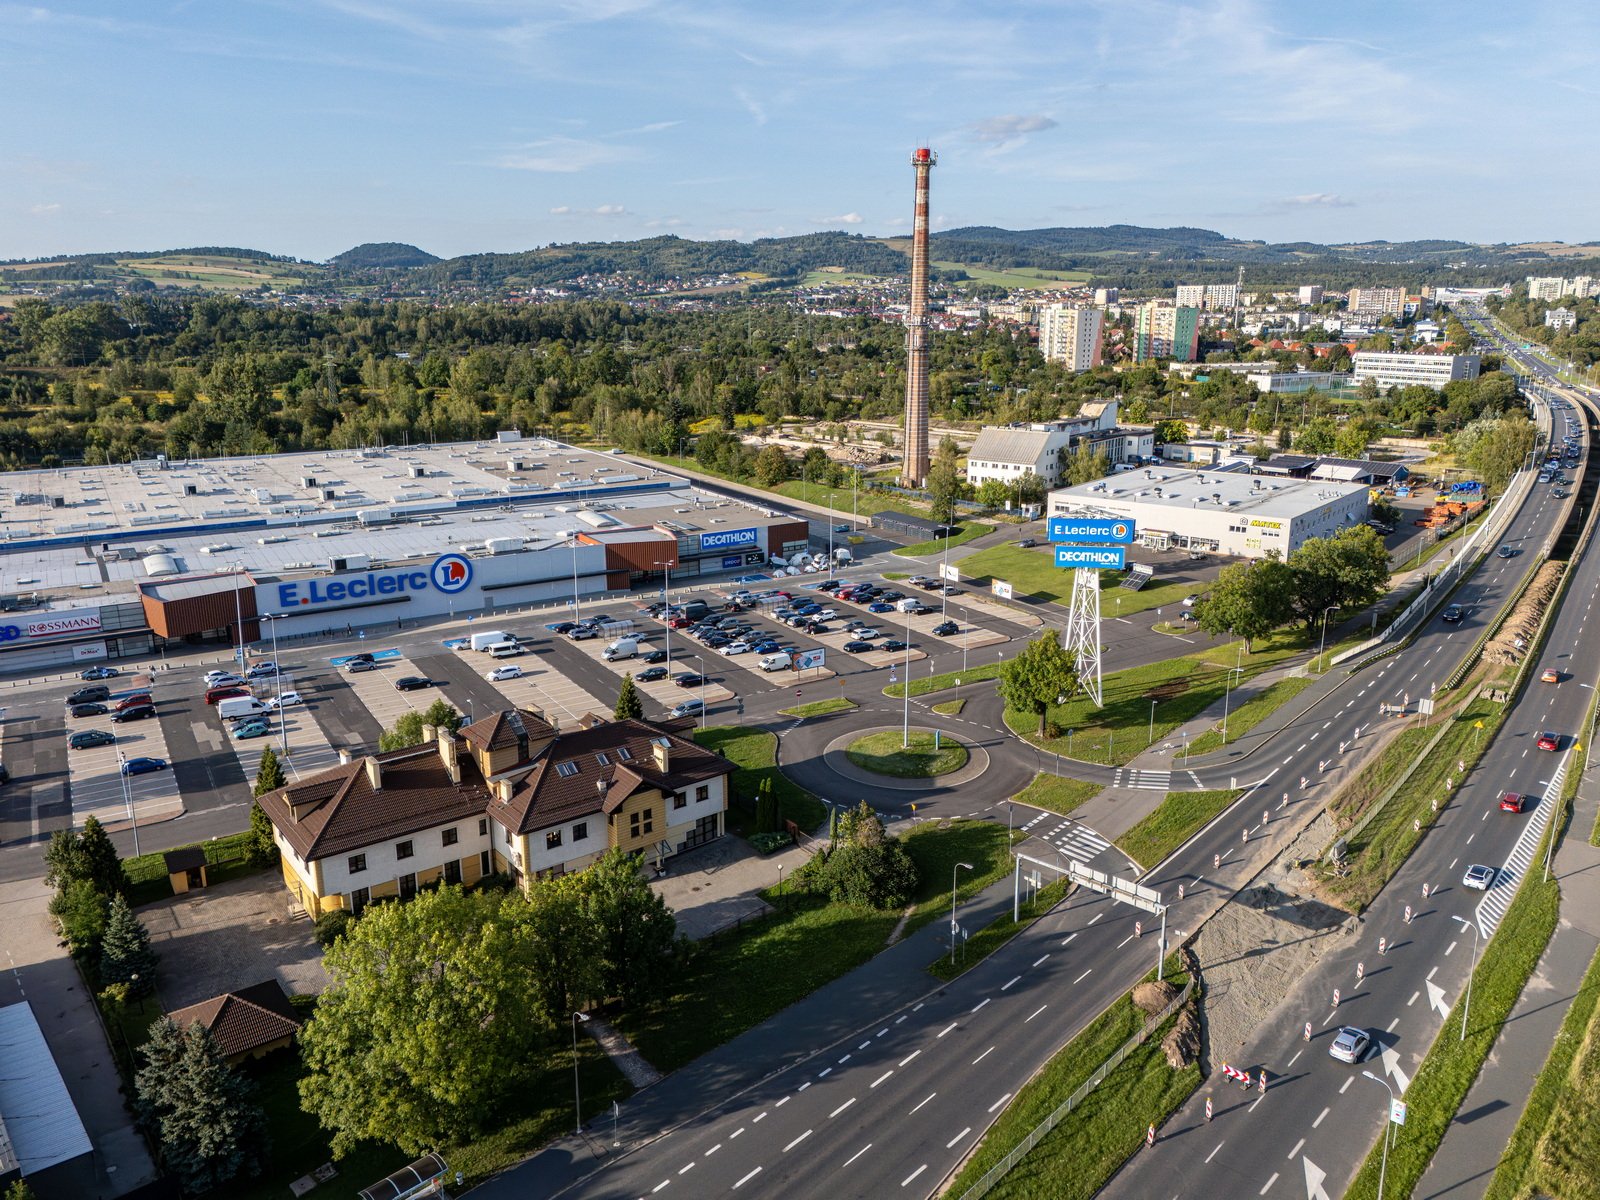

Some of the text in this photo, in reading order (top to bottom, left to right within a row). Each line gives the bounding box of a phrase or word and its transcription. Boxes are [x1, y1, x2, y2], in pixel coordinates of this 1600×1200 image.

[1054, 525, 1110, 536] E.Leclerc
[704, 531, 754, 546] DECATHLON
[1059, 551, 1120, 563] DECATHLON
[279, 571, 427, 607] E.Leclerc
[29, 616, 100, 633] ROSSMANN
